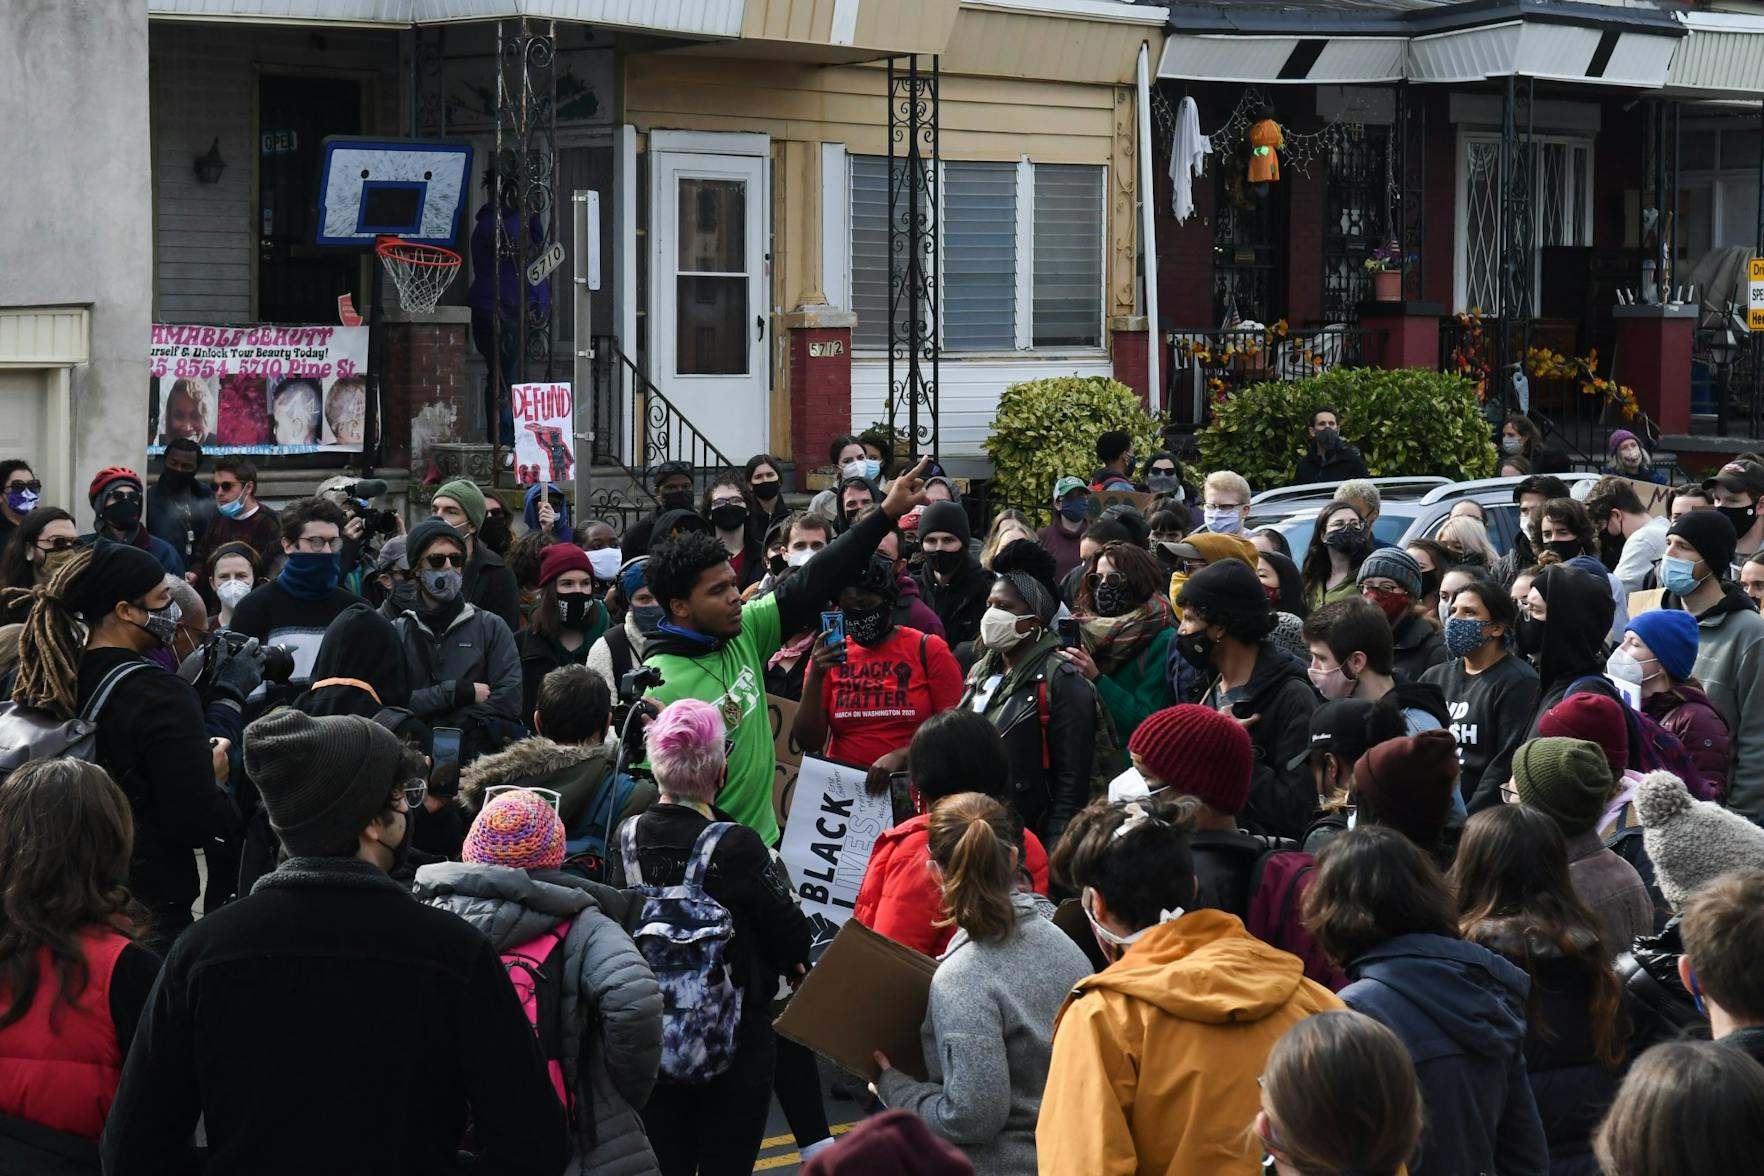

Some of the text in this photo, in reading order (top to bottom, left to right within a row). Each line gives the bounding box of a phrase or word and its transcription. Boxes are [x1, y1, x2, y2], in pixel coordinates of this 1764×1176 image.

[532, 246, 561, 281] 5710
[181, 347, 190, 357] &
[193, 347, 228, 358] Unlock
[256, 348, 292, 360] Beauty
[293, 347, 329, 360] Today!
[811, 341, 842, 356] 5712
[239, 359, 283, 379] 5710
[287, 359, 333, 379] Pine
[512, 385, 572, 421] DEFUND
[839, 660, 894, 679] BLACK
[835, 709, 916, 719] MARCH ON WASHINGTON 2020
[799, 792, 854, 905] BLACK
[832, 814, 881, 911] LIVES
